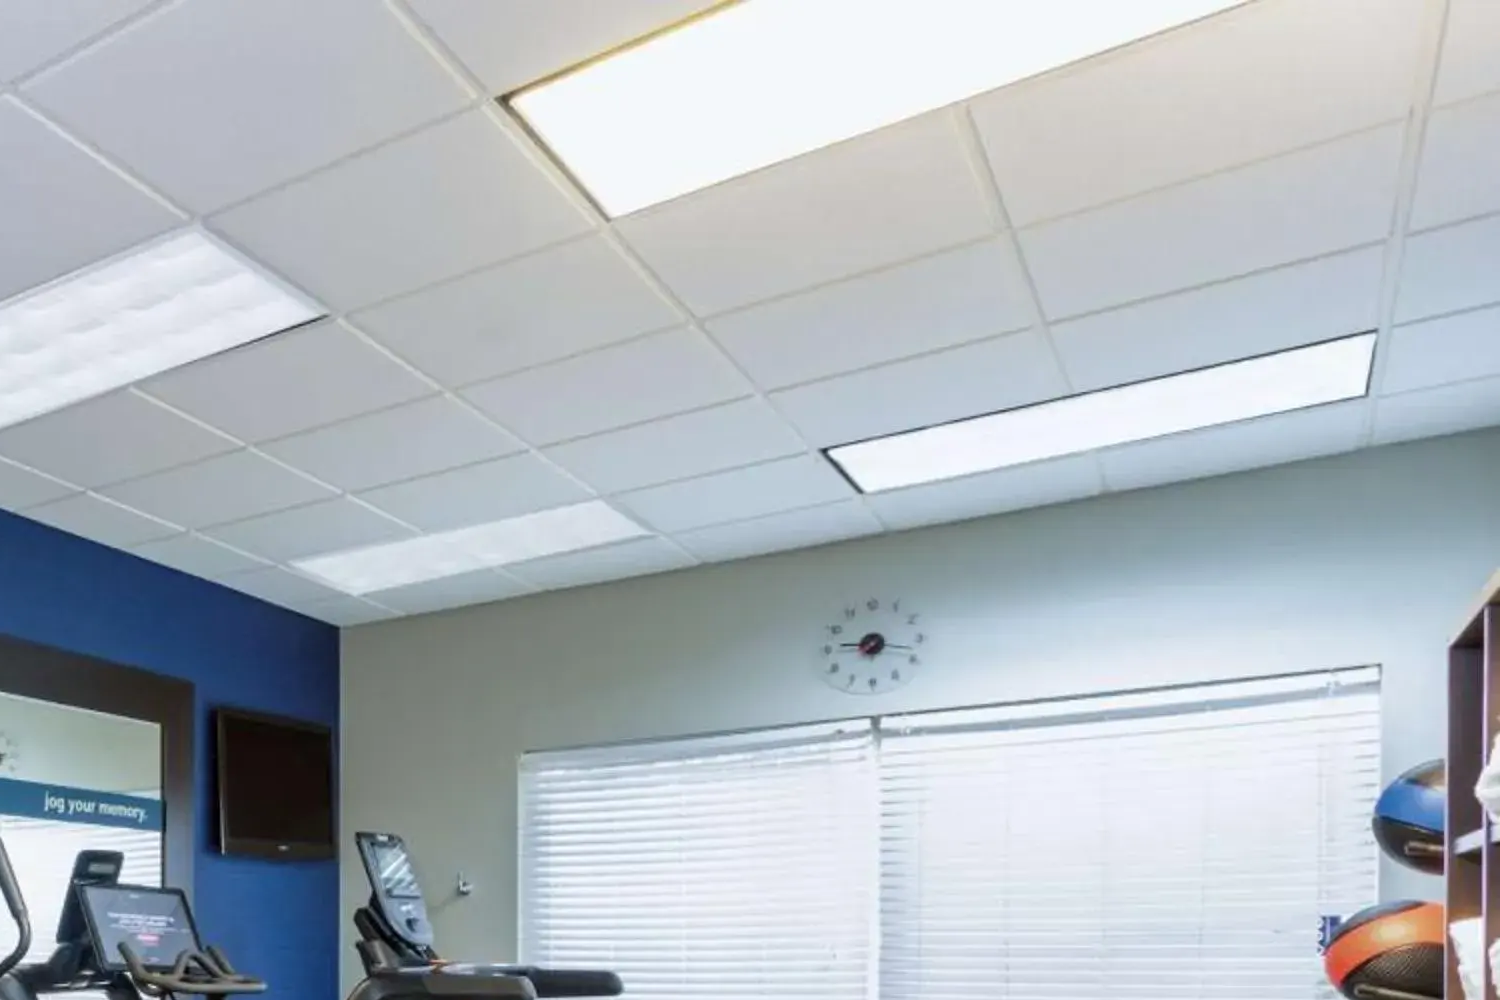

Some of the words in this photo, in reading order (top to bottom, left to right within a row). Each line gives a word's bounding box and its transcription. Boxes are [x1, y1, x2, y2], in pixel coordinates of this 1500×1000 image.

[44, 790, 65, 813] jog
[68, 799, 96, 815] your
[99, 803, 149, 824] memory.
